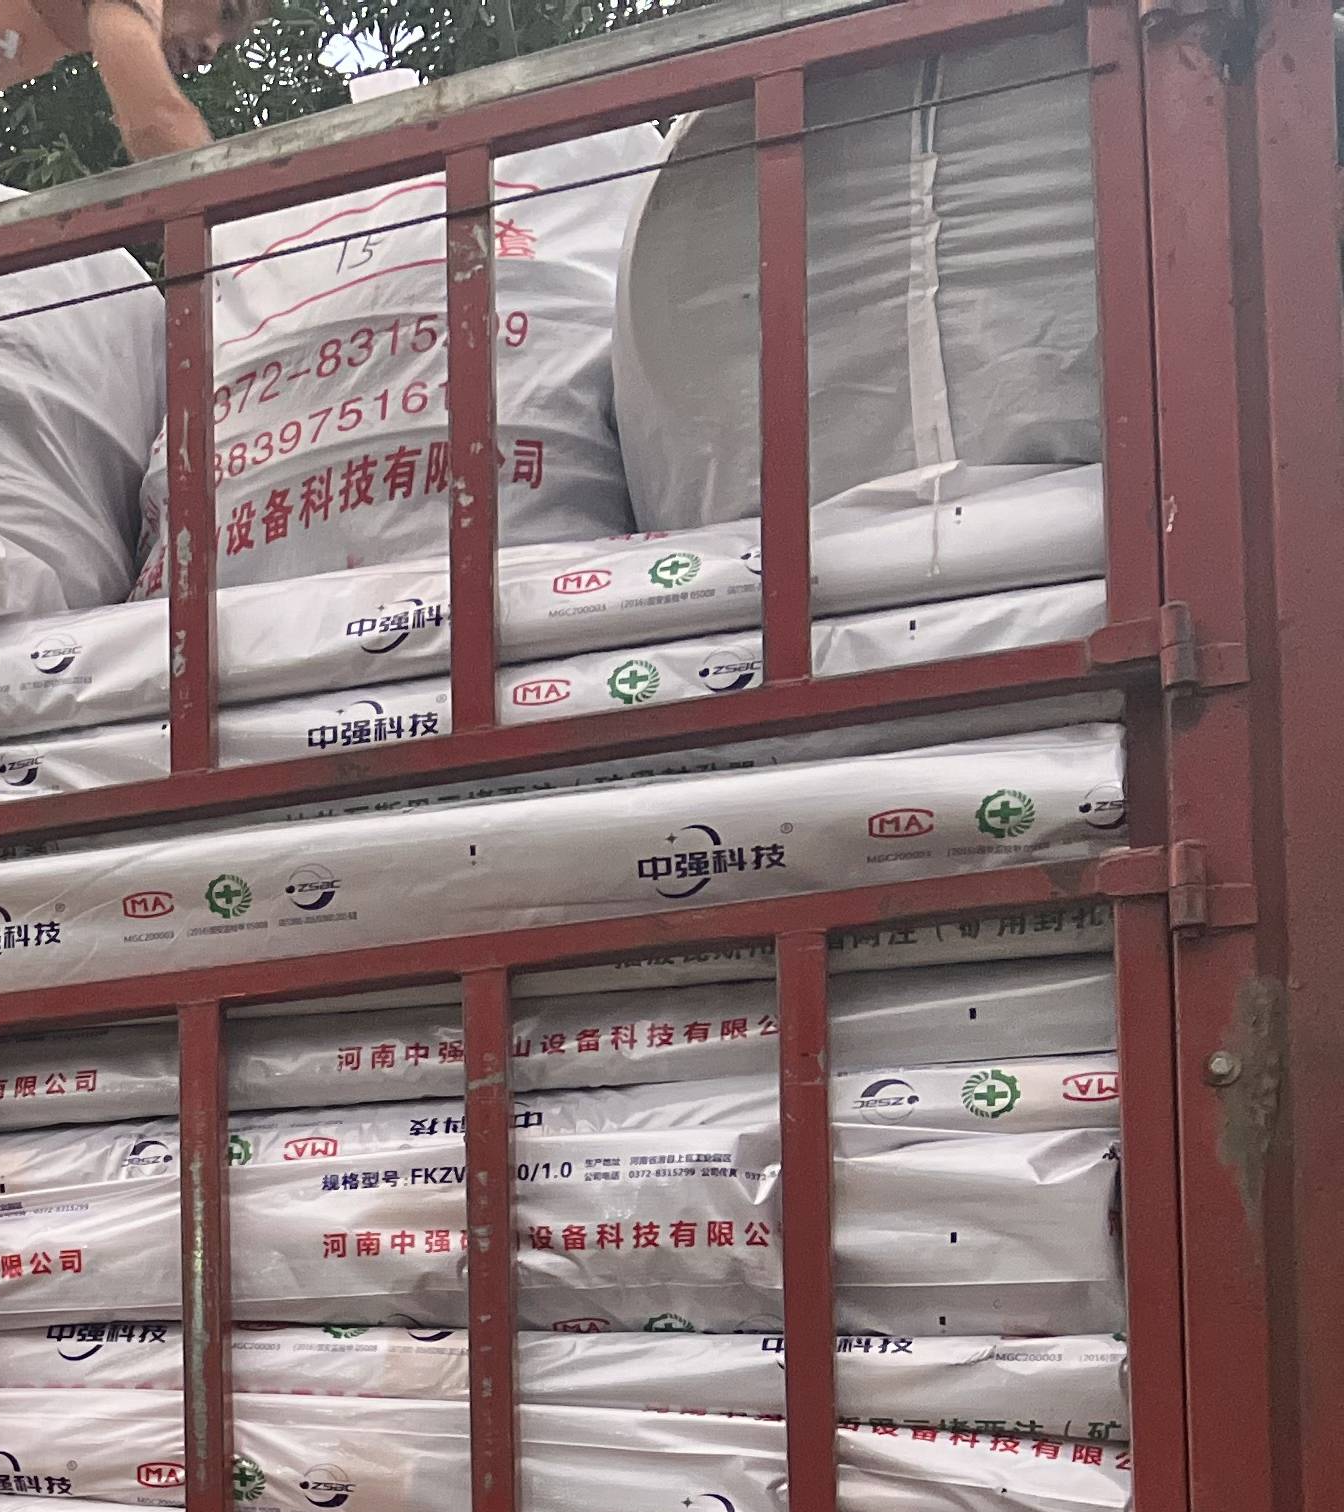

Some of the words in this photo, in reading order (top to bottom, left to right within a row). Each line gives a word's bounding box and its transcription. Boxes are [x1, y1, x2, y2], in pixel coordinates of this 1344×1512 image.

[216, 439, 543, 556] 设备科技有限司
[346, 602, 450, 640] 中强科
[307, 711, 438, 750] 中强科技
[878, 814, 923, 833] MA
[637, 844, 787, 882] 中强科技
[129, 895, 167, 914] MA
[337, 1015, 780, 1071] 河南中强山设备科技有限公
[322, 1220, 770, 1260] 河南中强设备科技有限公
[145, 1468, 178, 1483] MA
